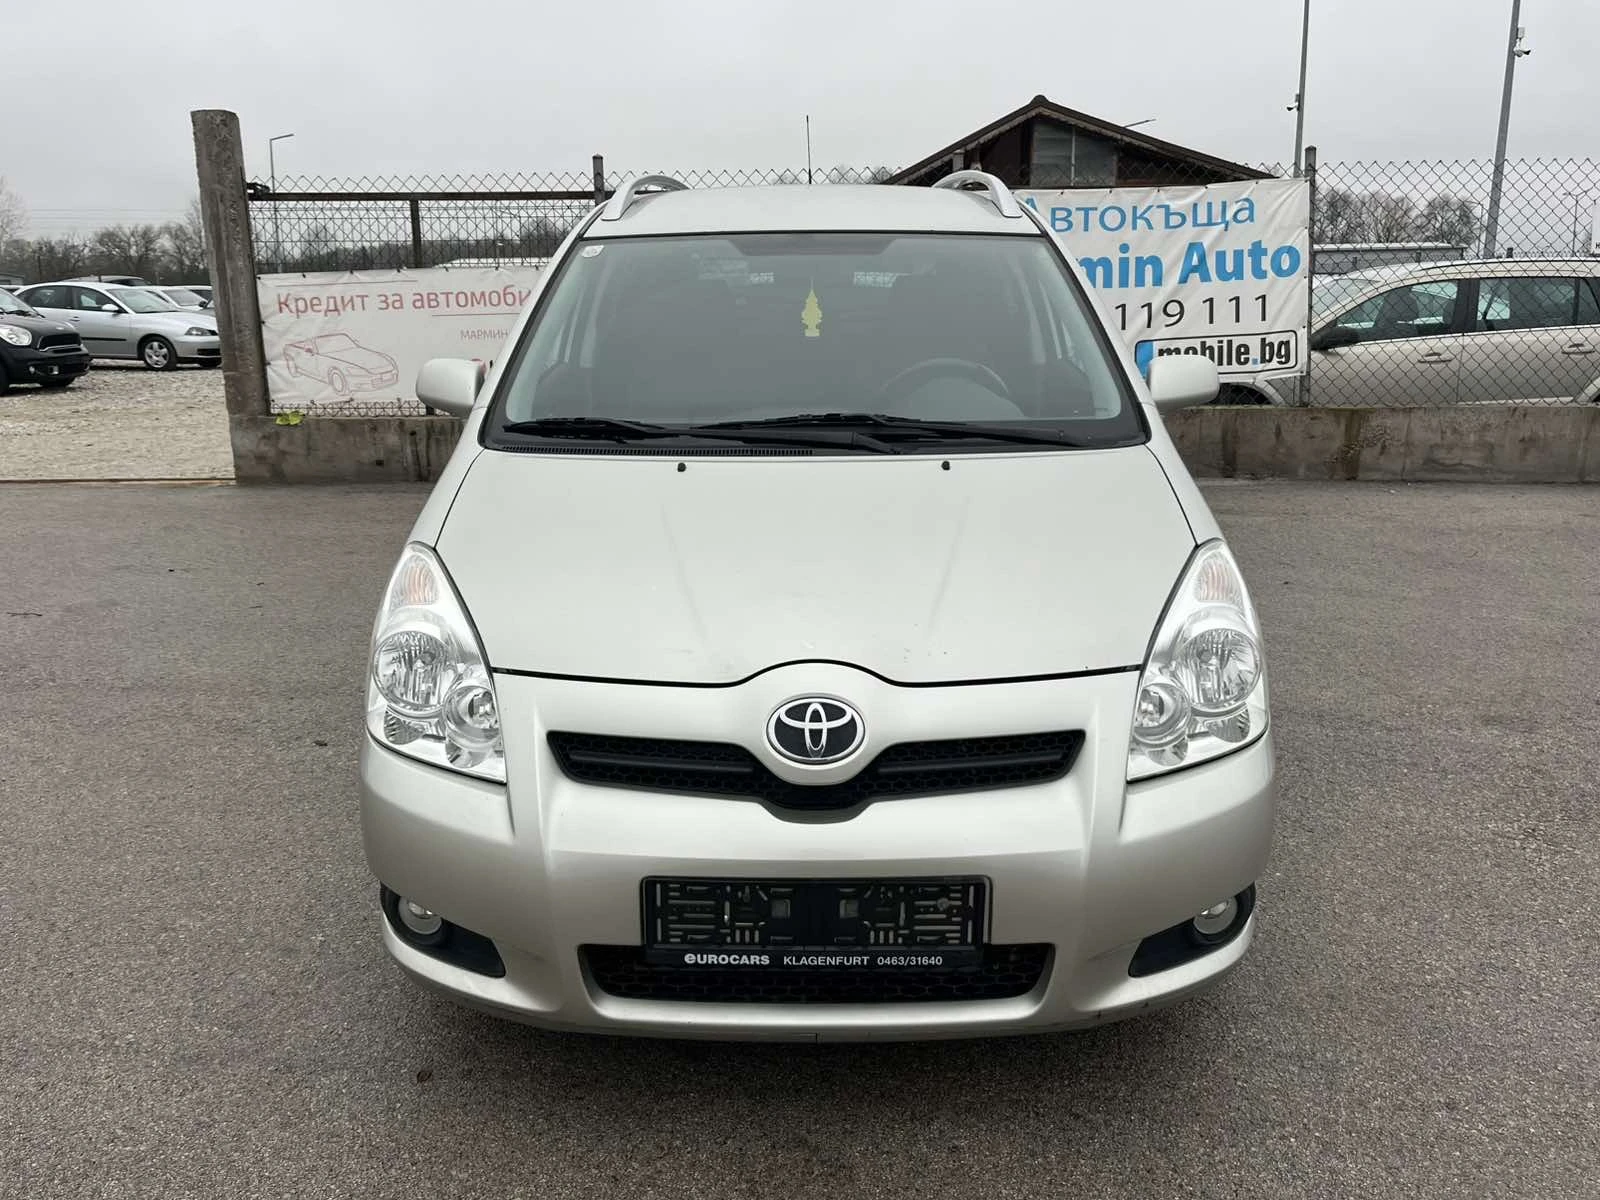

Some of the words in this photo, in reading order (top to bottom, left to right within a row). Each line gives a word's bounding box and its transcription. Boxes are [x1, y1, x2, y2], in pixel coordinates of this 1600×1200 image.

[1177, 239, 1301, 284] Auto
[277, 292, 369, 318] Кредит
[377, 292, 404, 311] за
[1114, 299, 1185, 331] 119
[1202, 294, 1267, 325] 111
[783, 956, 870, 966] KLAGENFURT
[877, 956, 943, 966] 0463/31640
